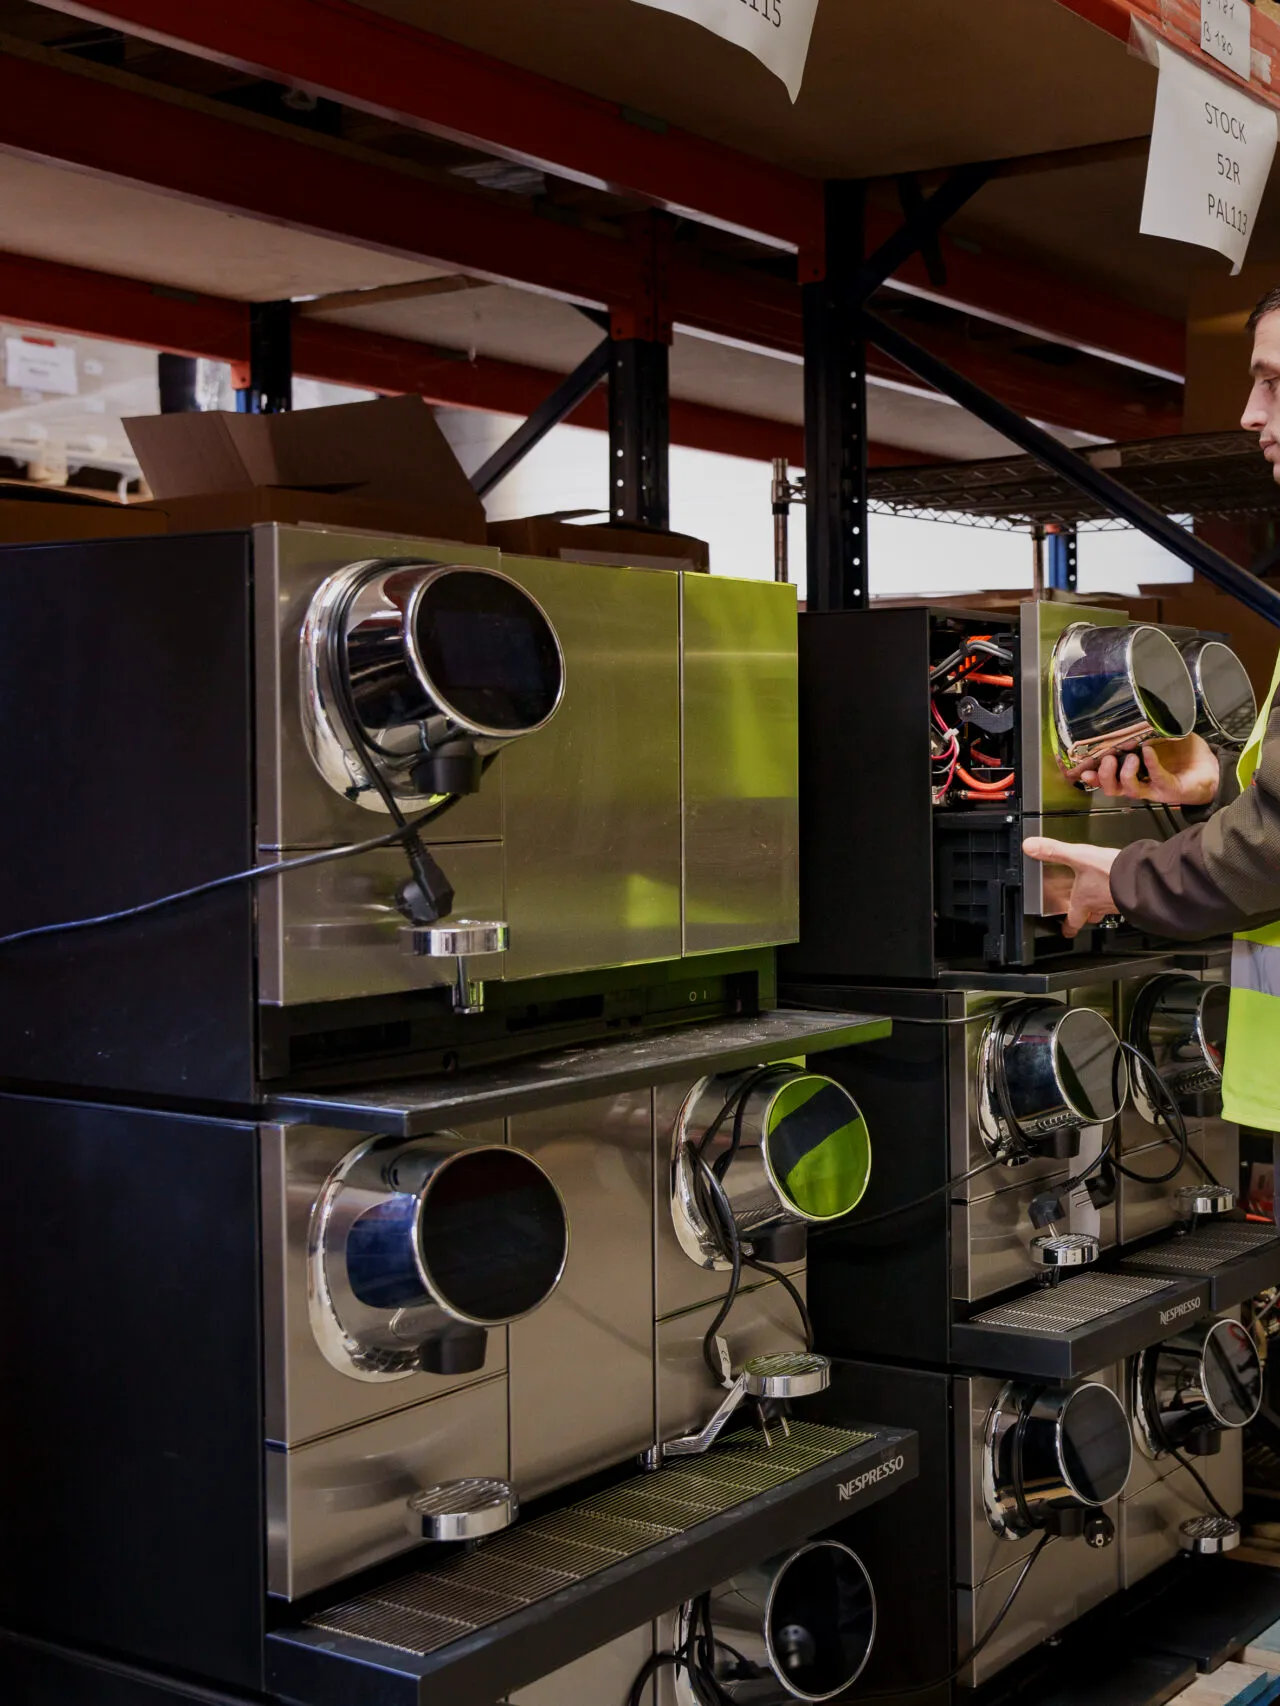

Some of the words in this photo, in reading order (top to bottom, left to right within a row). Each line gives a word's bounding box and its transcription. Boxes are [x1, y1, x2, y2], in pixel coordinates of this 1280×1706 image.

[1205, 102, 1247, 144] STOCK
[1217, 152, 1241, 185] 52R
[1207, 193, 1248, 236] PAL113
[1158, 1296, 1201, 1325] NESPRESSO
[836, 1455, 904, 1501] NESPRESSO
